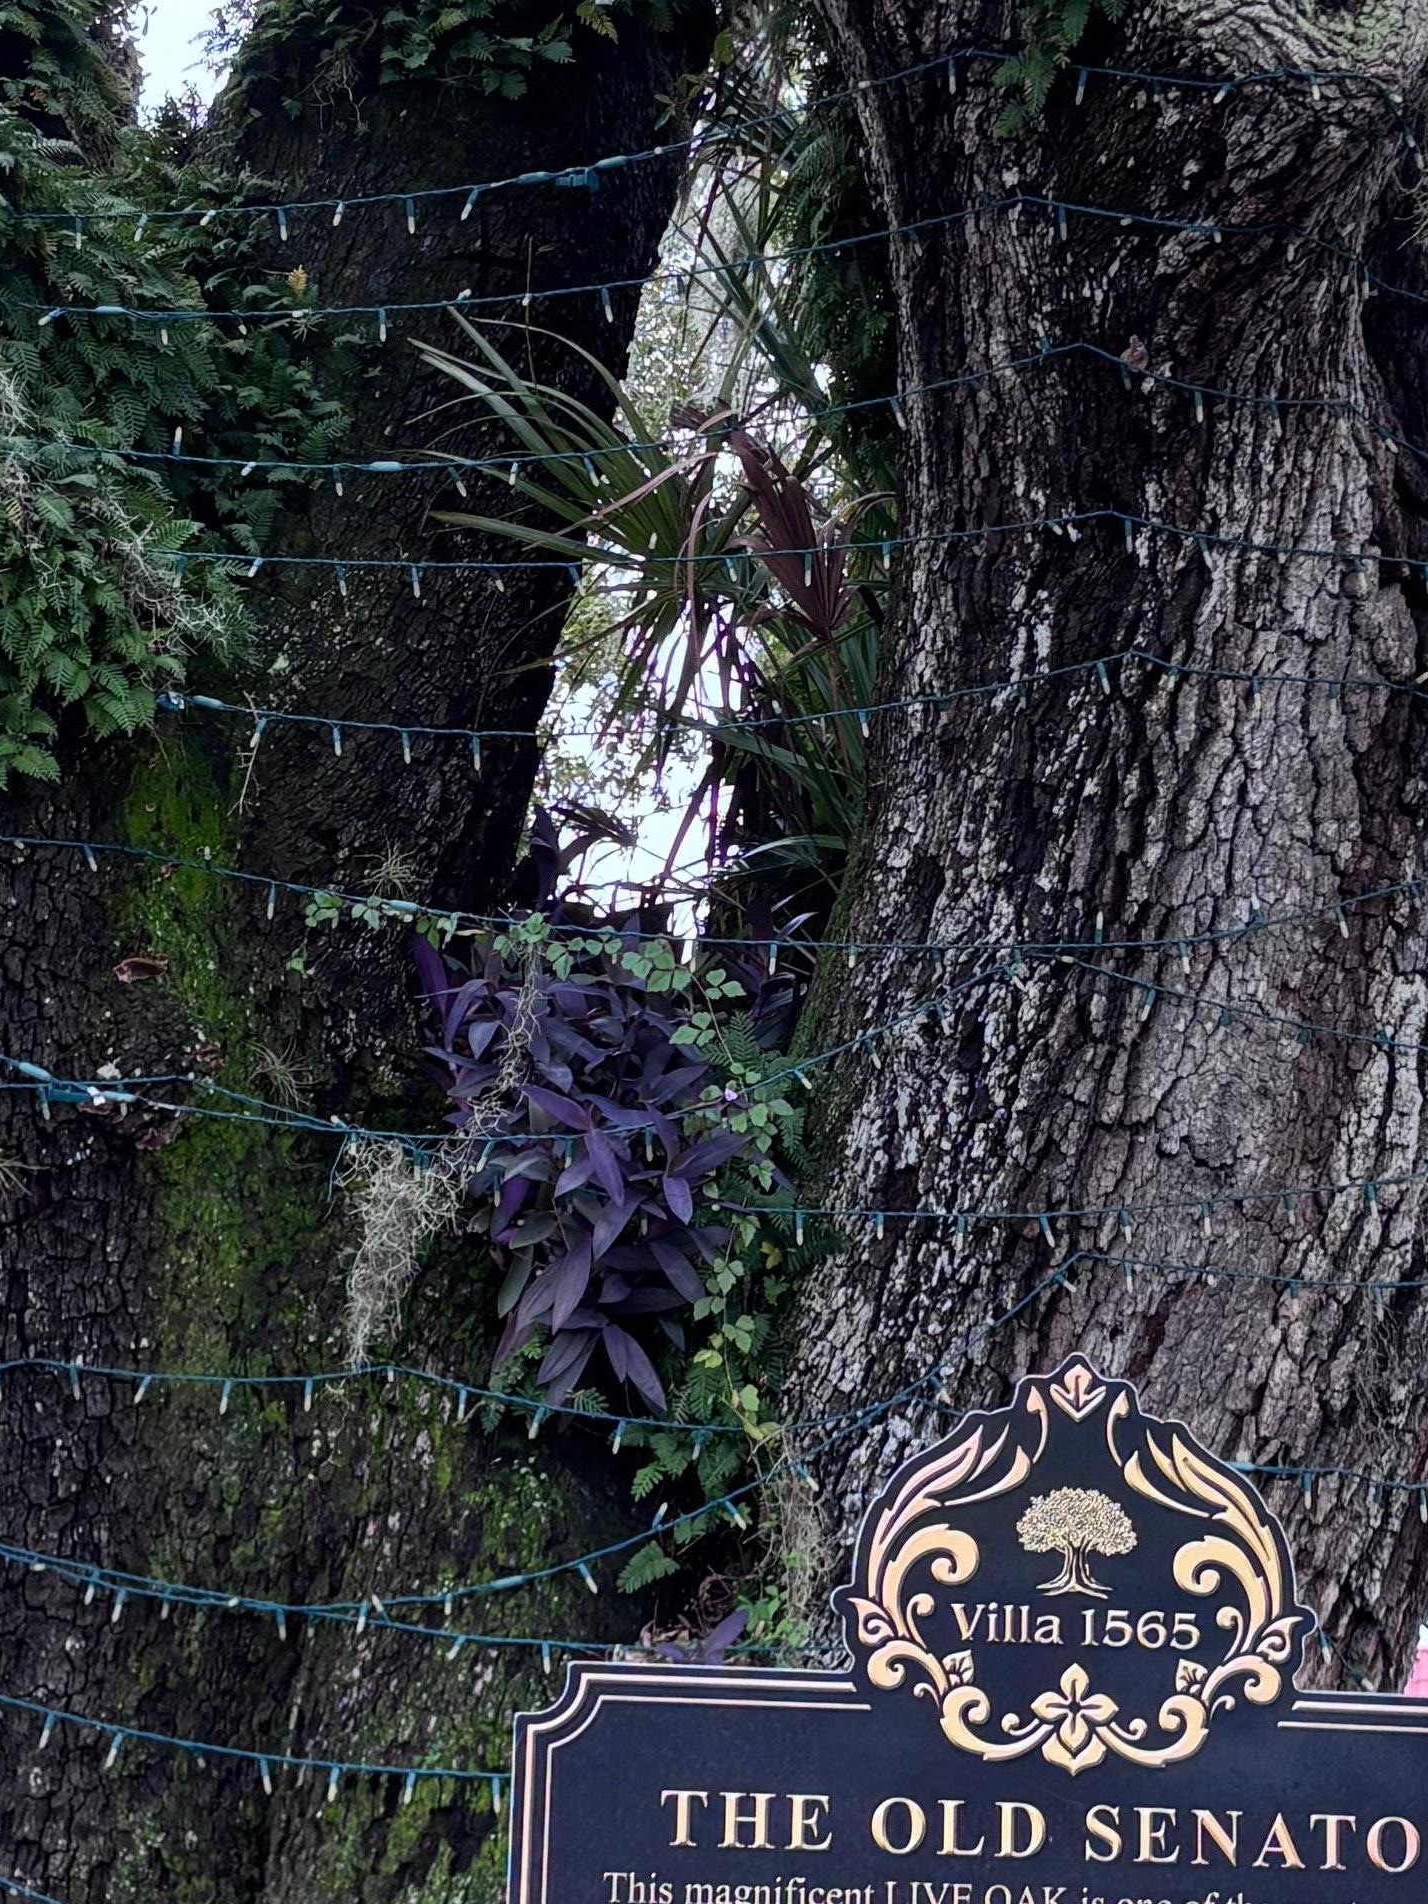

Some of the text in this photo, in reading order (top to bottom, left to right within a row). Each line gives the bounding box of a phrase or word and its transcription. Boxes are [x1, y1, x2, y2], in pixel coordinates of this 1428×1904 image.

[950, 1601, 1201, 1651] Villa 1565
[660, 1789, 833, 1851] THE
[871, 1796, 1046, 1858] OLD
[603, 1871, 673, 1904] This
